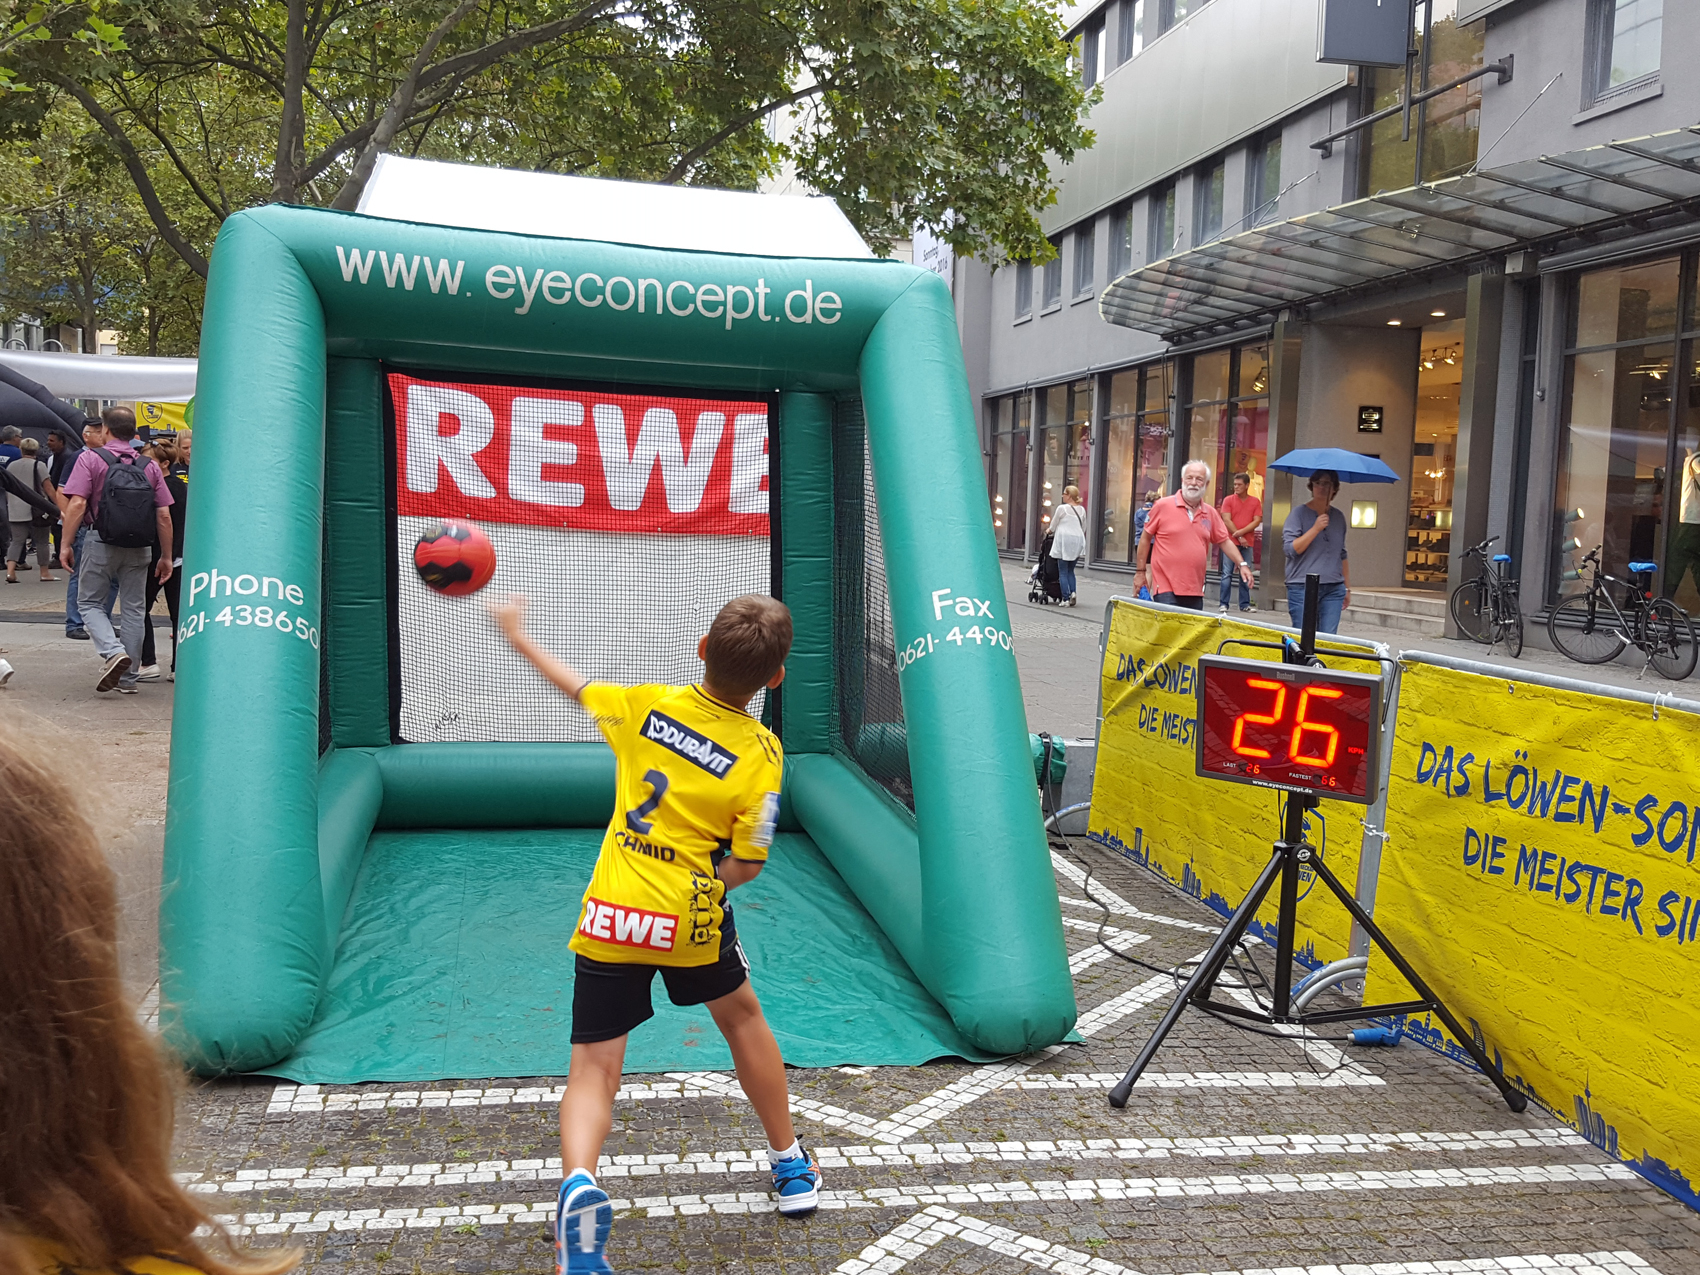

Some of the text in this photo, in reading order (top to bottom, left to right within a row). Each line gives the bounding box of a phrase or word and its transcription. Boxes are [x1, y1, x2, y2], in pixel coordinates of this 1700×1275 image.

[189, 568, 304, 607] Phone
[932, 588, 994, 620] Fax
[1116, 653, 1146, 687] DAS
[1139, 703, 1197, 750] DIE MEIST
[1231, 678, 1343, 768] 26
[1223, 761, 1260, 774] LAST 26
[1348, 746, 1364, 755] KPH
[1416, 741, 1475, 798] DAS
[1252, 780, 1313, 794] www.eyeconcept.de
[1289, 772, 1336, 787] FASTEST 66
[626, 768, 669, 835] 2
[1463, 827, 1507, 875] DIE
[1514, 844, 1643, 935] MEISTER
[580, 900, 675, 948] REWE
